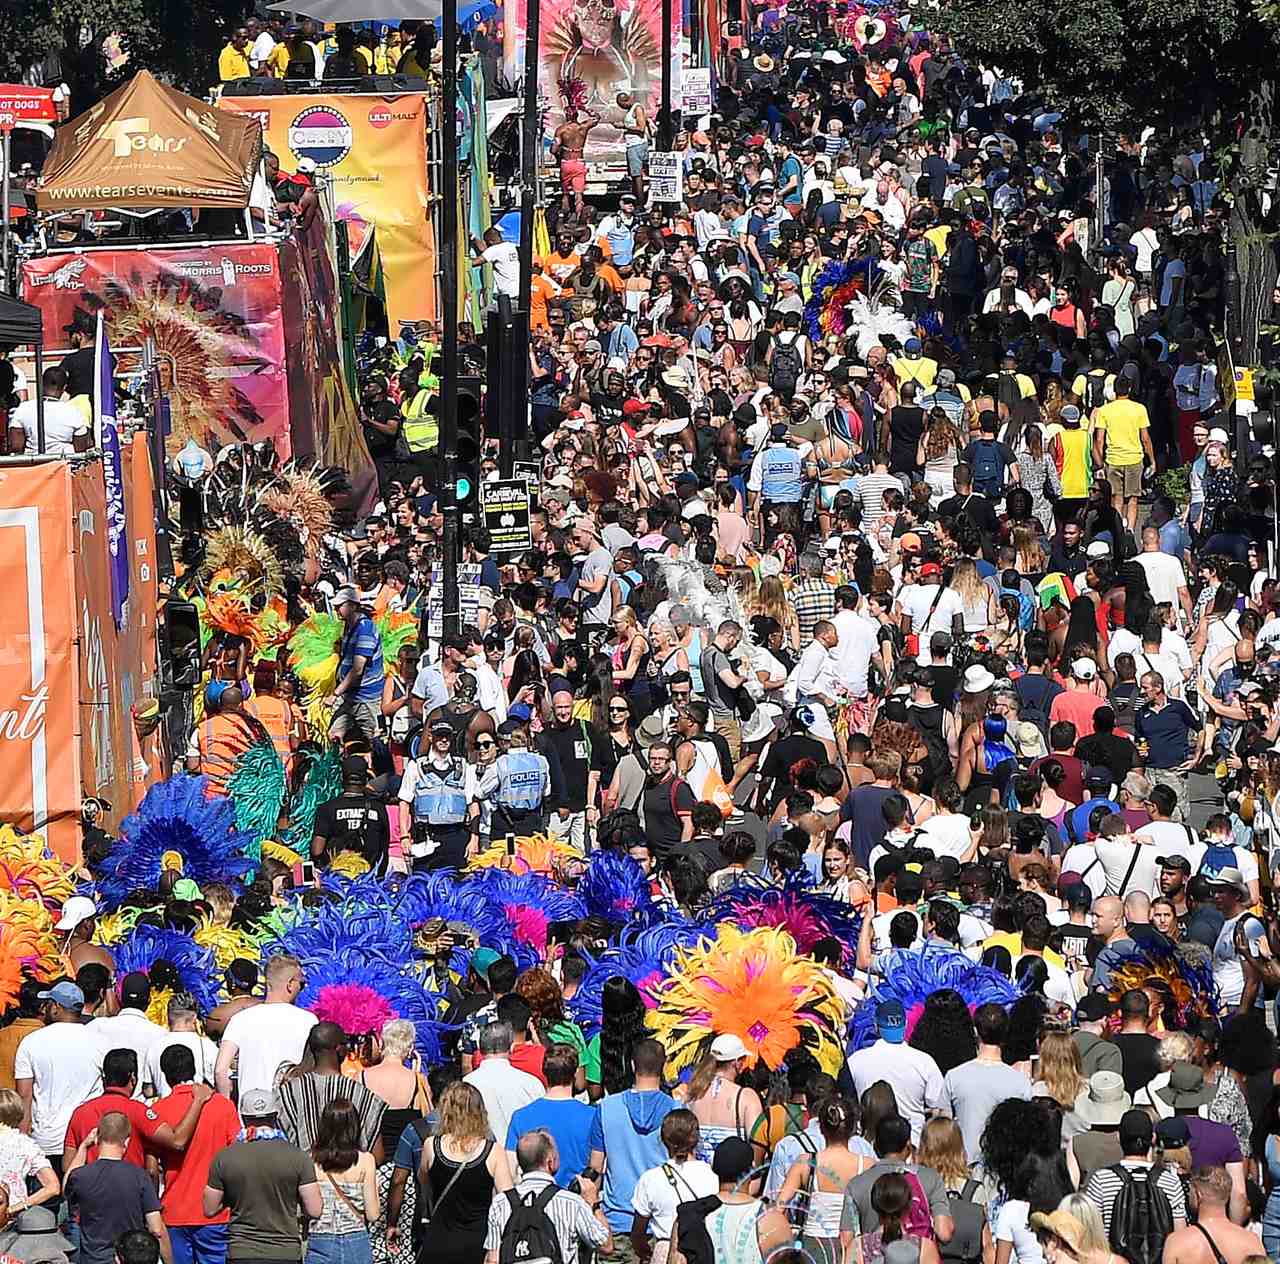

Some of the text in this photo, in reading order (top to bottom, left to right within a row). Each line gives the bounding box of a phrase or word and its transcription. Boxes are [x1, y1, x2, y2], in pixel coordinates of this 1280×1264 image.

[15, 100, 39, 109] DOGS
[0, 113, 15, 124] PR
[235, 264, 272, 275] ROOTS
[510, 771, 540, 783] POLICE
